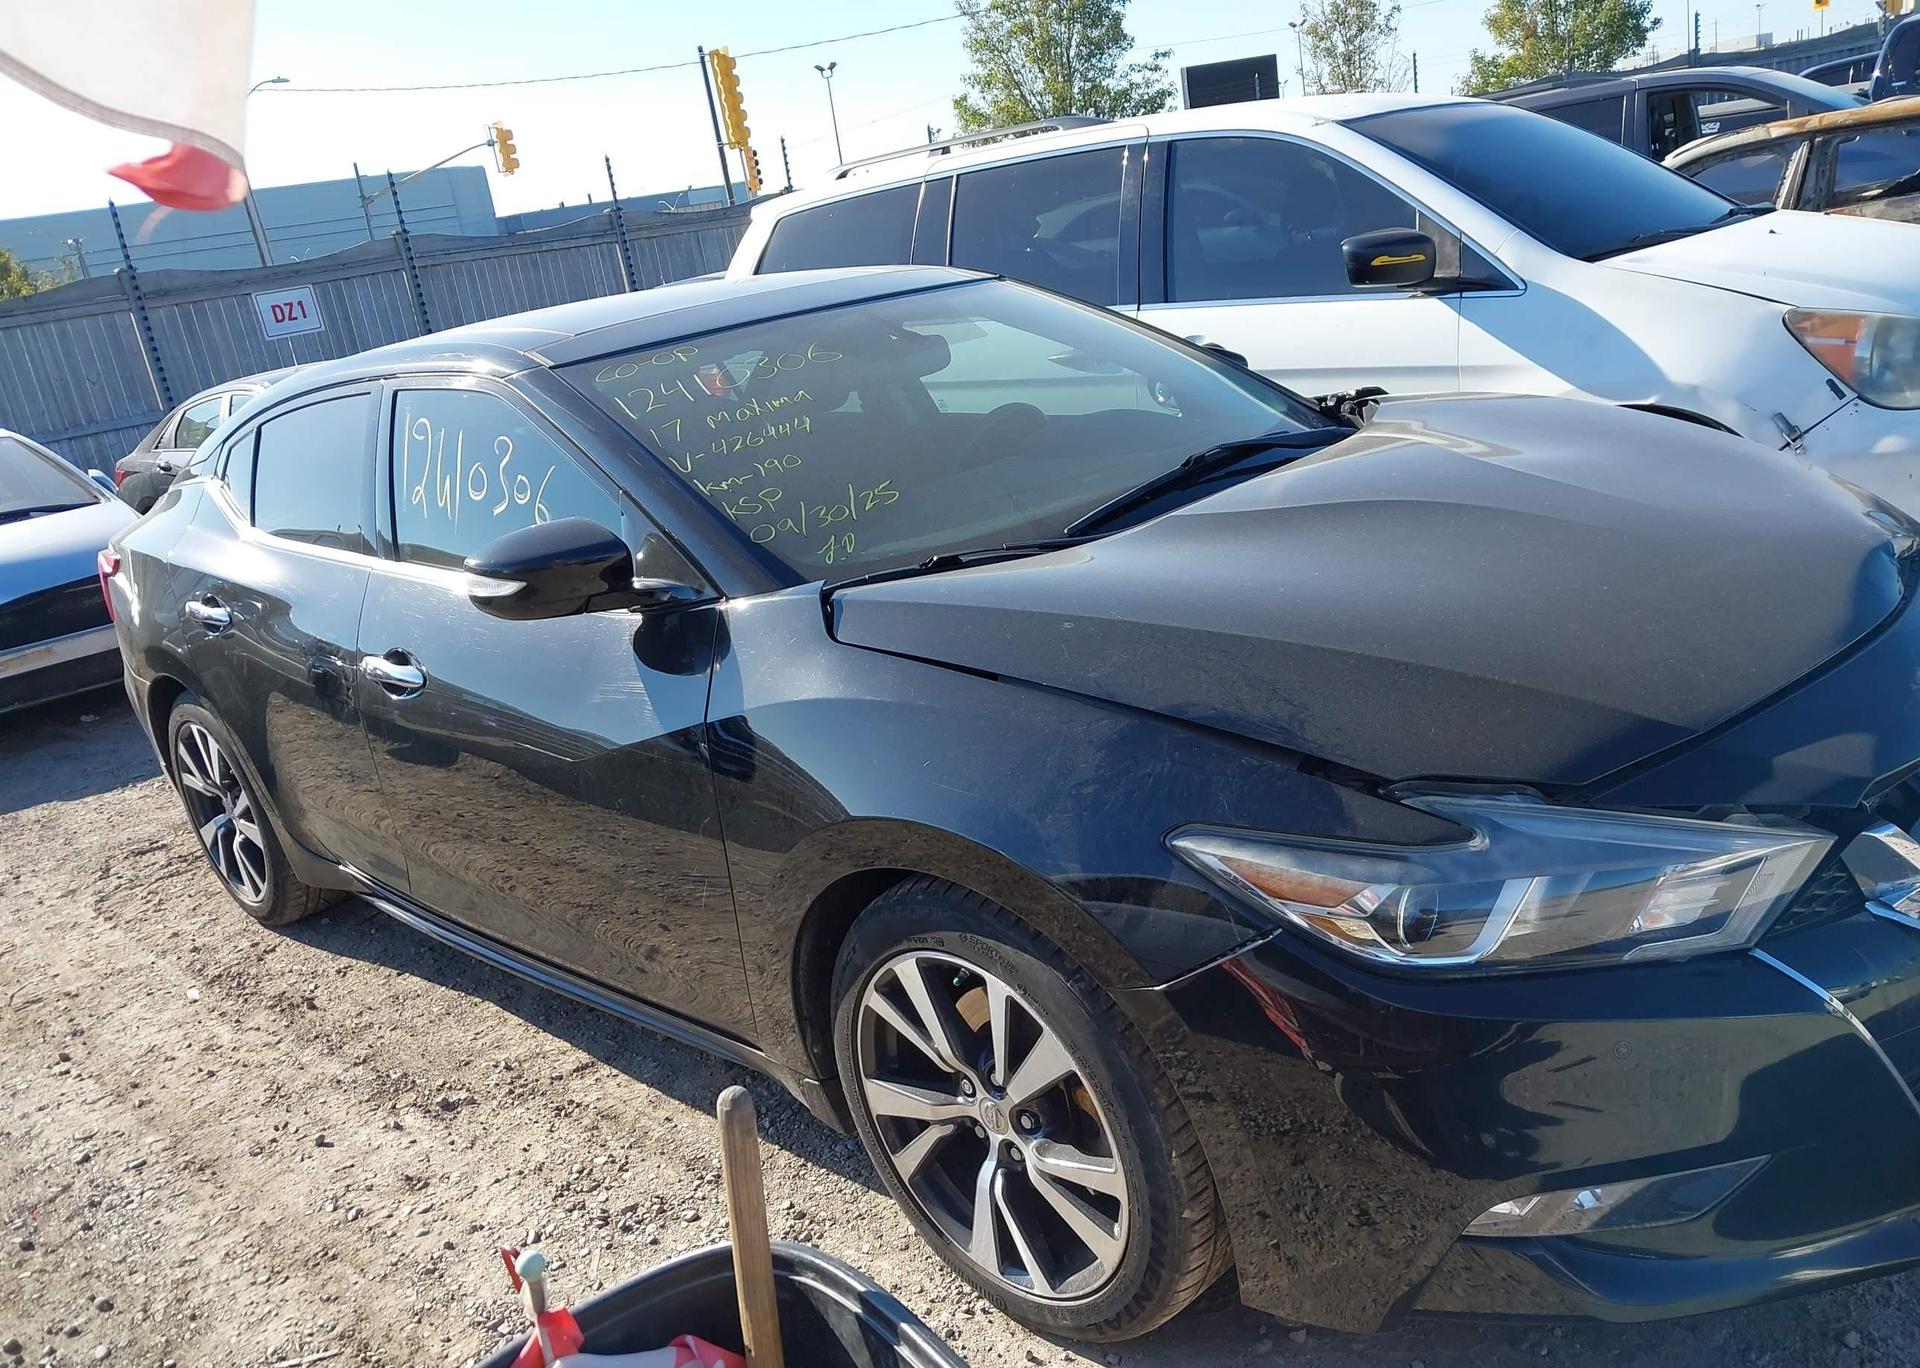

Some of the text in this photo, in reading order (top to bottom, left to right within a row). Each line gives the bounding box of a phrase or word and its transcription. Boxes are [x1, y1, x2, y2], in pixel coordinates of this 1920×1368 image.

[270, 300, 307, 323] DZ1
[614, 342, 844, 420] 12410306
[650, 418, 682, 448] 17
[402, 406, 556, 535] 12410306
[749, 479, 900, 543] 09/30/25
